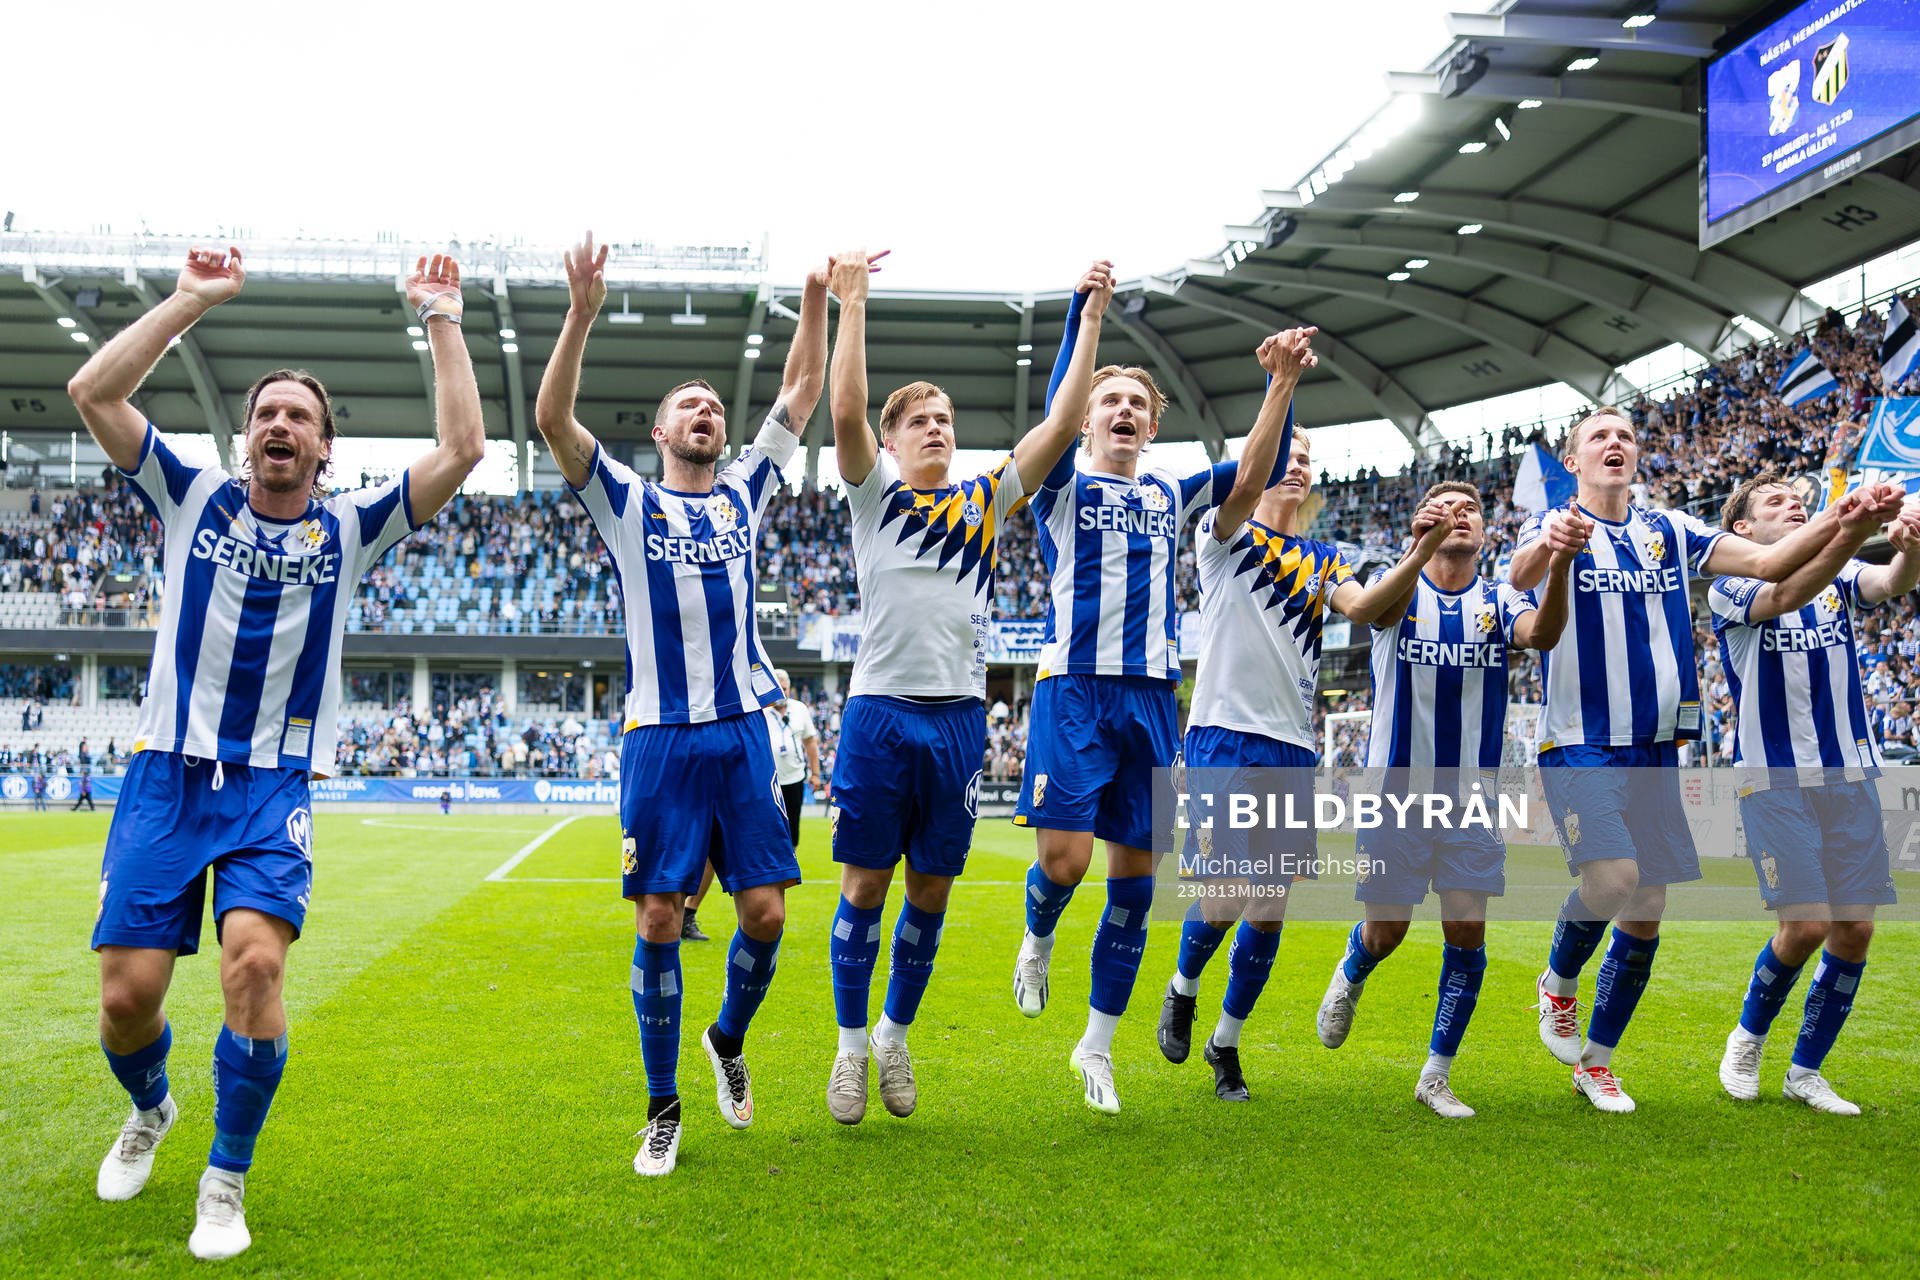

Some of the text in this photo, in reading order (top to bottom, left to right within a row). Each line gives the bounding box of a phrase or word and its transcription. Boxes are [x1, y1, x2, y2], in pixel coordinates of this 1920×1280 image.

[1775, 133, 1837, 174] GAMLA ULLEVI
[1822, 204, 1879, 232] H3
[12, 398, 47, 413] F5
[616, 411, 647, 425] F3
[1079, 505, 1175, 539] SERNEKE
[646, 525, 751, 564] SERNEKE
[1579, 567, 1680, 593] SERNEKE
[1436, 970, 1468, 1036] SILFVERLOK
